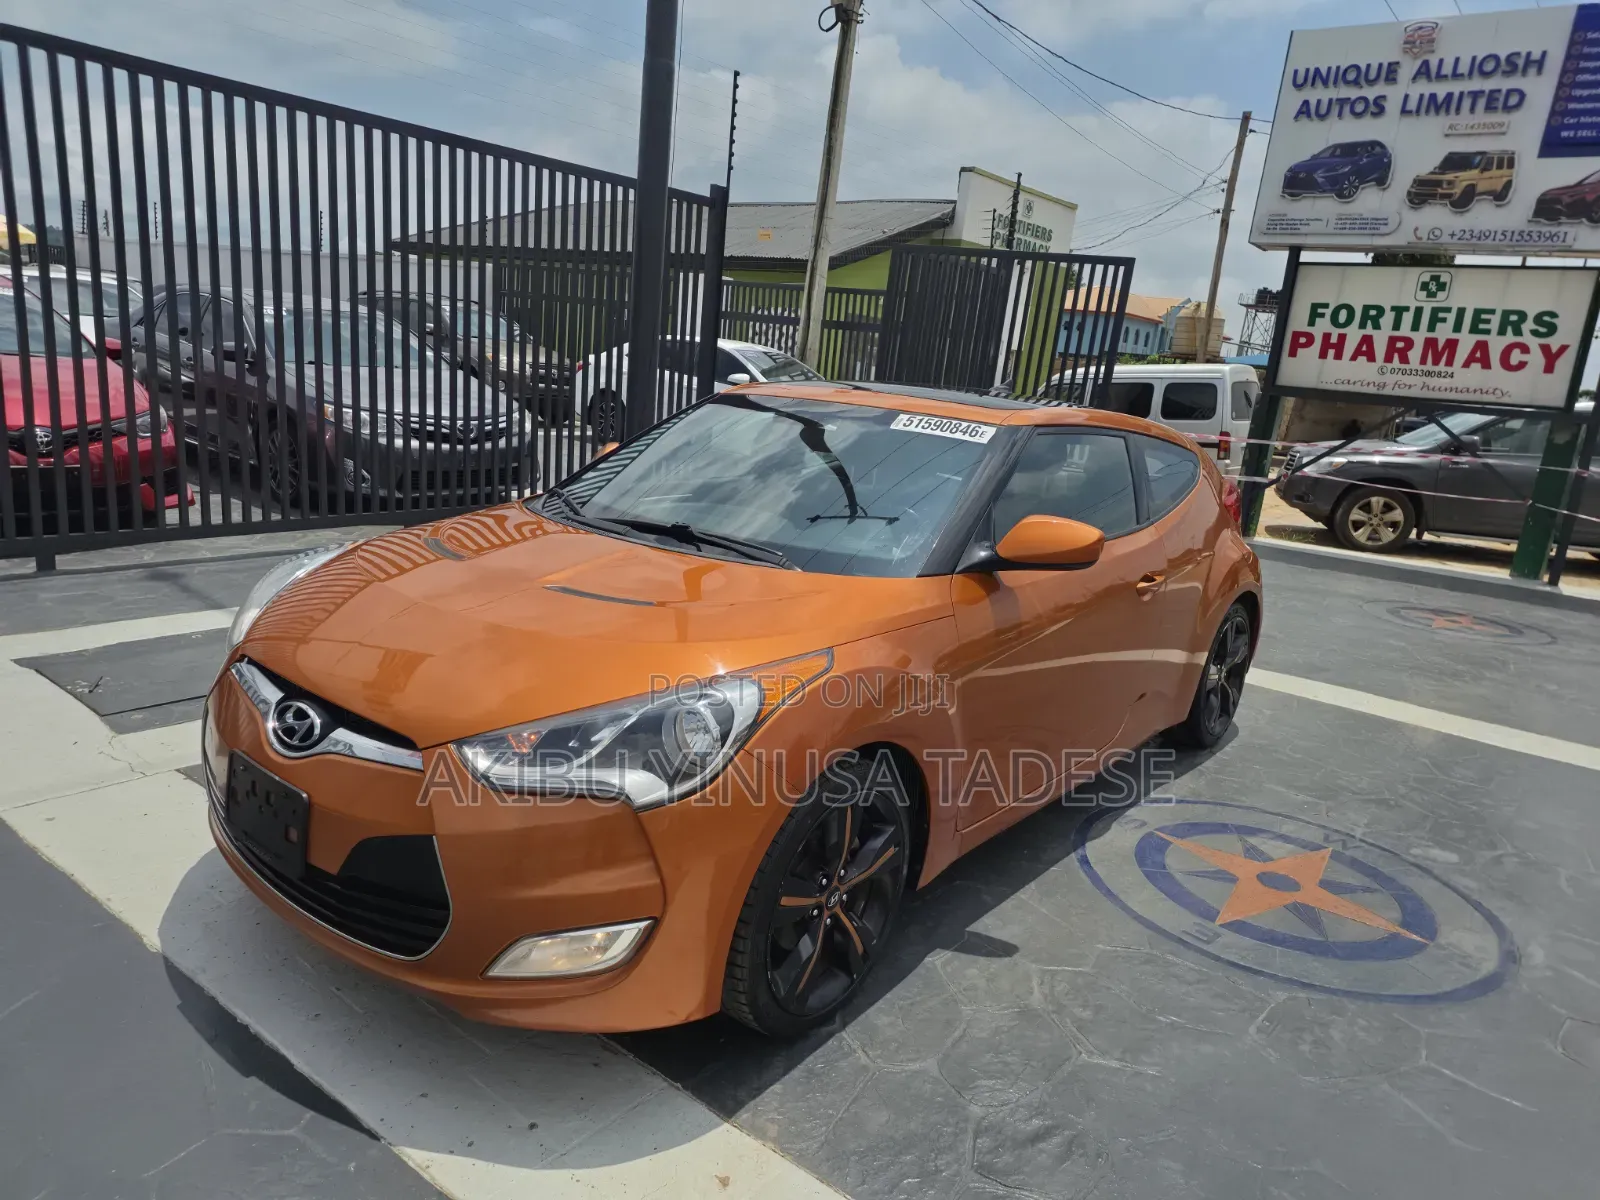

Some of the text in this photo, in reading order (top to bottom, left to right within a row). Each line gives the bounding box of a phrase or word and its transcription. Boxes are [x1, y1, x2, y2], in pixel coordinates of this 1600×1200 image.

[1292, 50, 1547, 91] UNIQUE ALLIOSH
[1293, 88, 1527, 121] AUTOS LIMITED
[997, 213, 1053, 242] FOTIFIERS
[1307, 302, 1560, 339] FORTIFIERS
[1287, 330, 1571, 375] PHARMACY
[1389, 367, 1455, 380] 07033300824
[1391, 379, 1417, 392] for
[1420, 381, 1512, 399] humanity.
